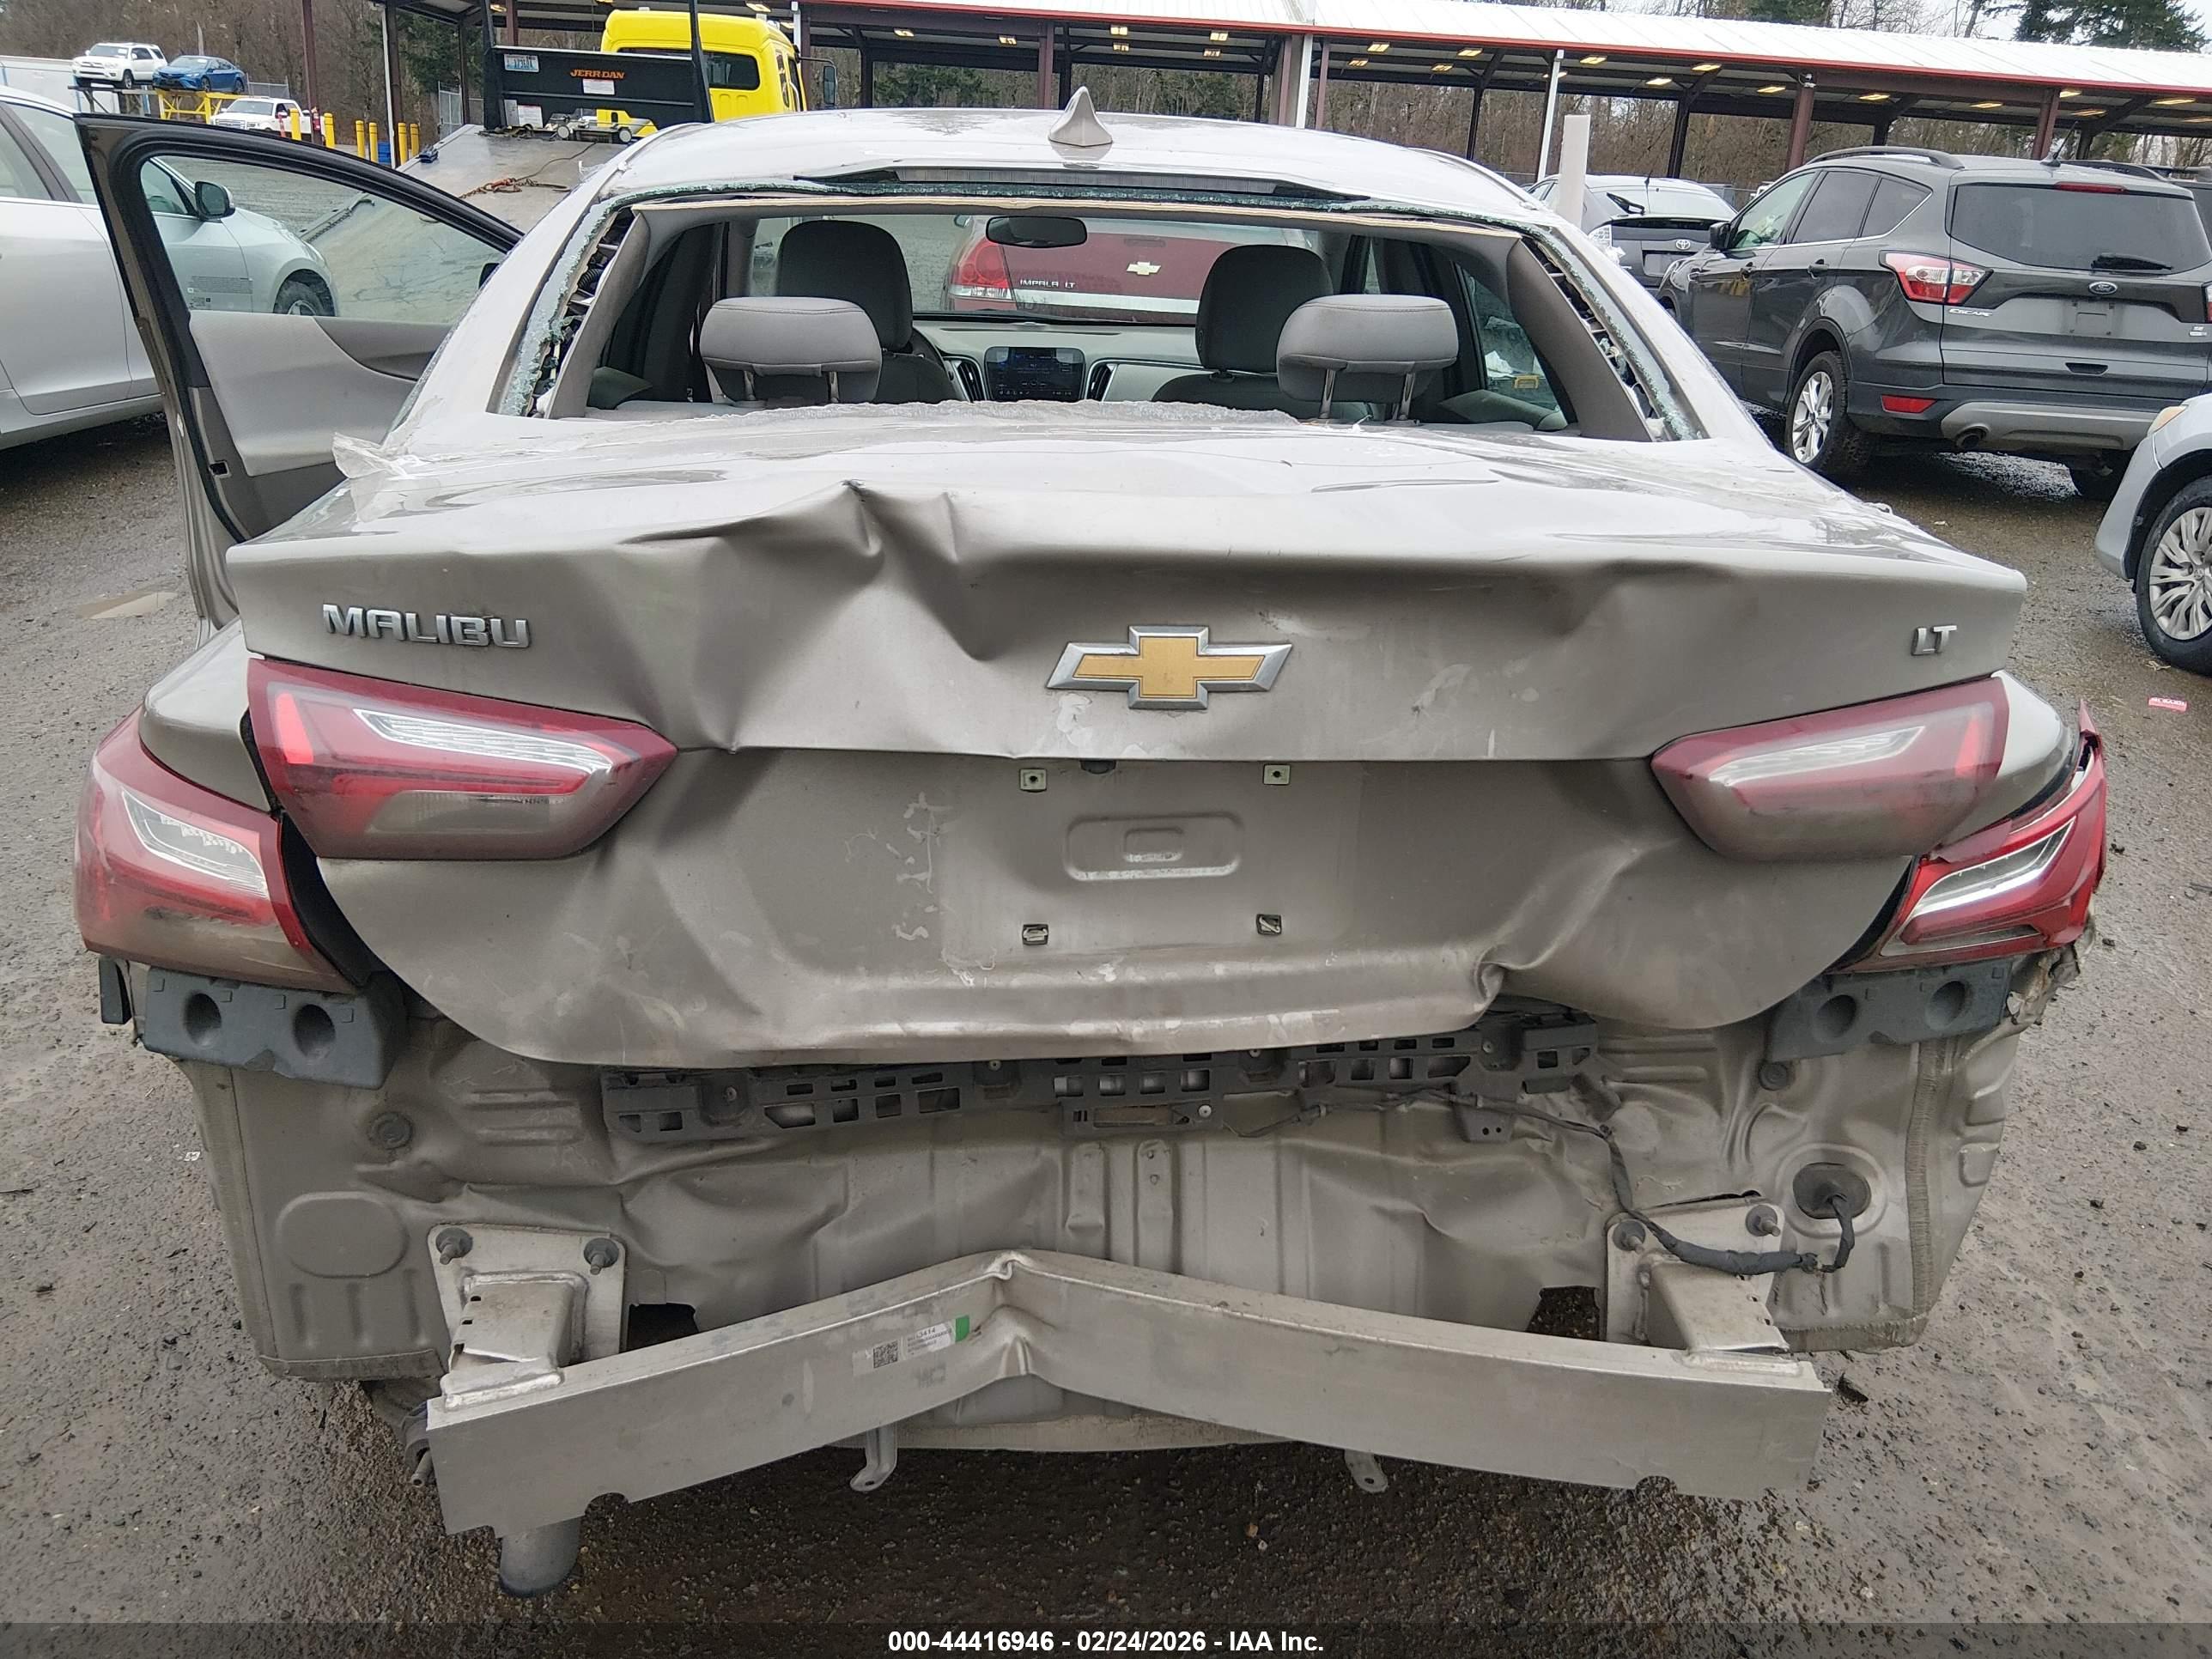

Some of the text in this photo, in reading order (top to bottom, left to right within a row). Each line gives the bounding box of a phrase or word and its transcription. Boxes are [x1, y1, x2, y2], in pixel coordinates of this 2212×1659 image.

[1020, 278, 1059, 288] IMPALA
[322, 604, 530, 648] MALIBU
[1911, 625, 1958, 656] LT
